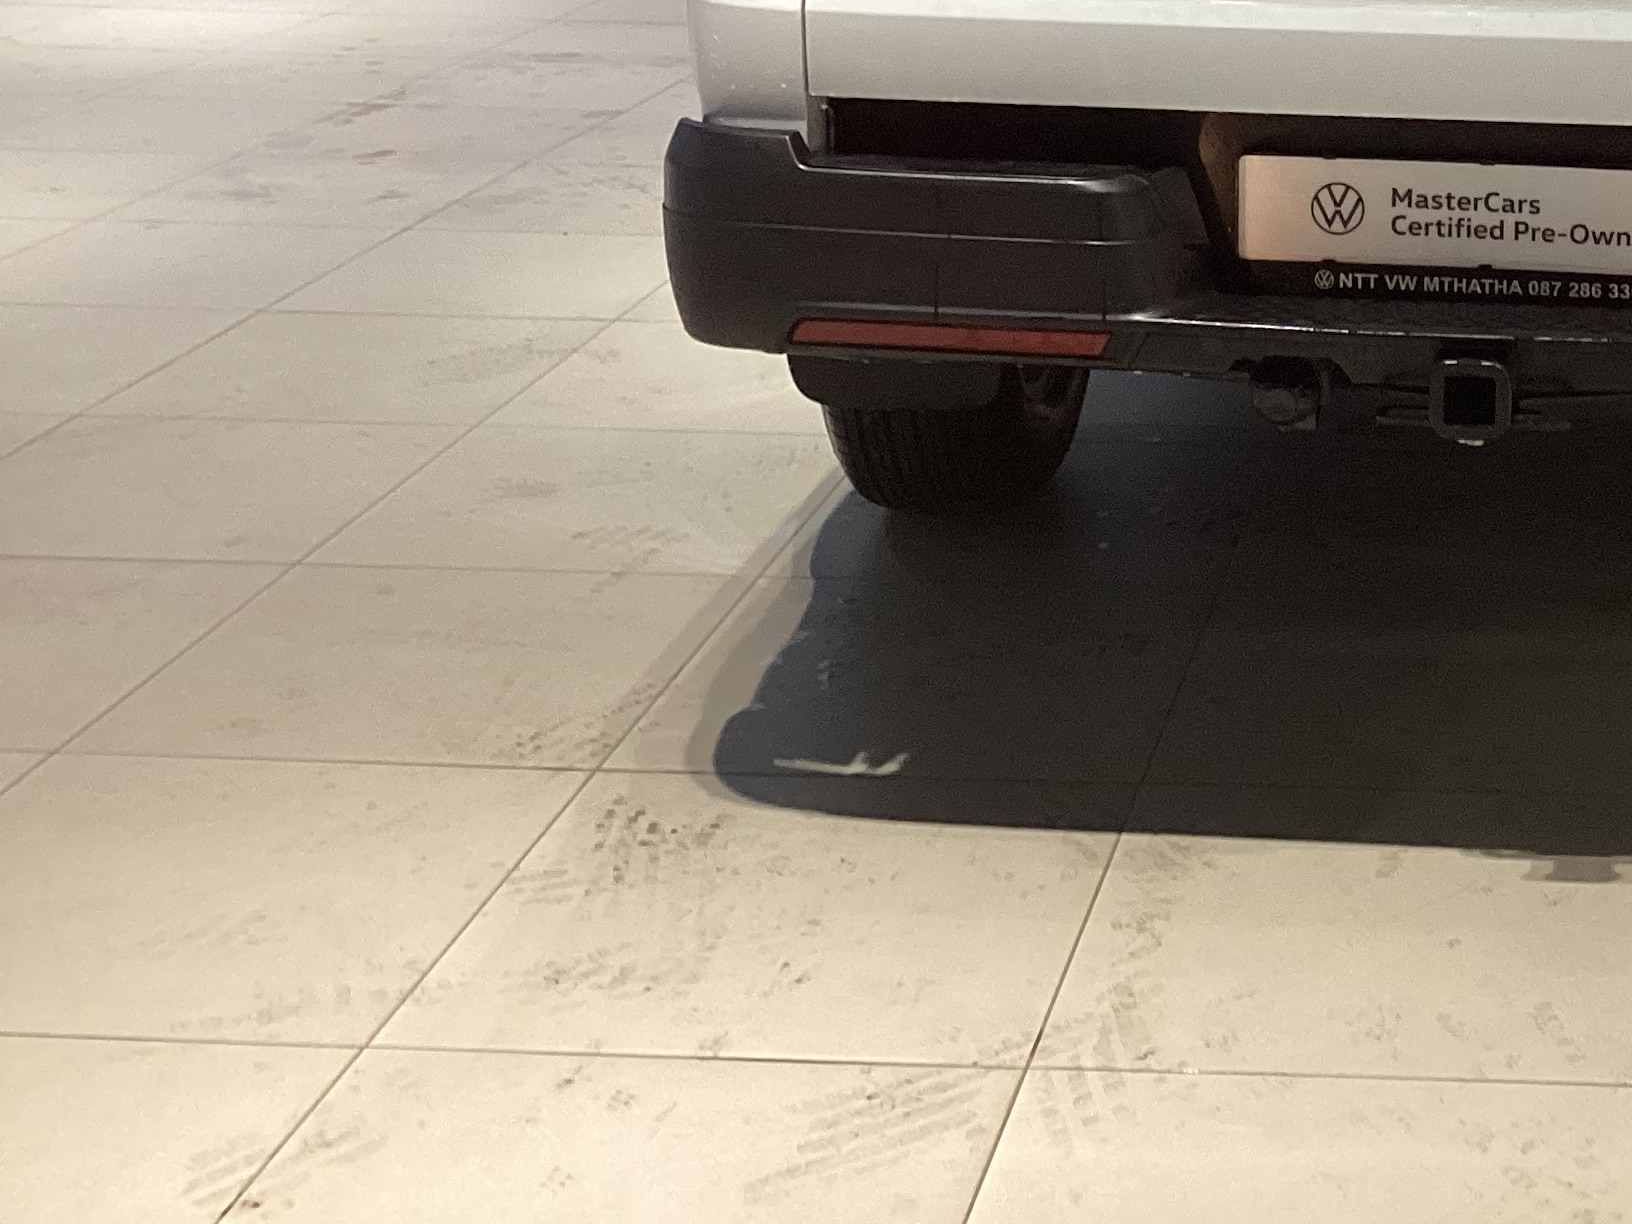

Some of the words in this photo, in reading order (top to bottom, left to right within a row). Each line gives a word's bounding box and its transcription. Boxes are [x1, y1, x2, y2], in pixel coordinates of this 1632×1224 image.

[1390, 187, 1541, 215] MasterCars
[1390, 214, 1505, 241] Certified
[1338, 272, 1379, 290] NTT
[1383, 274, 1418, 292] VW
[1423, 276, 1523, 296] MTHATHA
[1527, 280, 1562, 297] 087
[1568, 282, 1602, 299] 286
